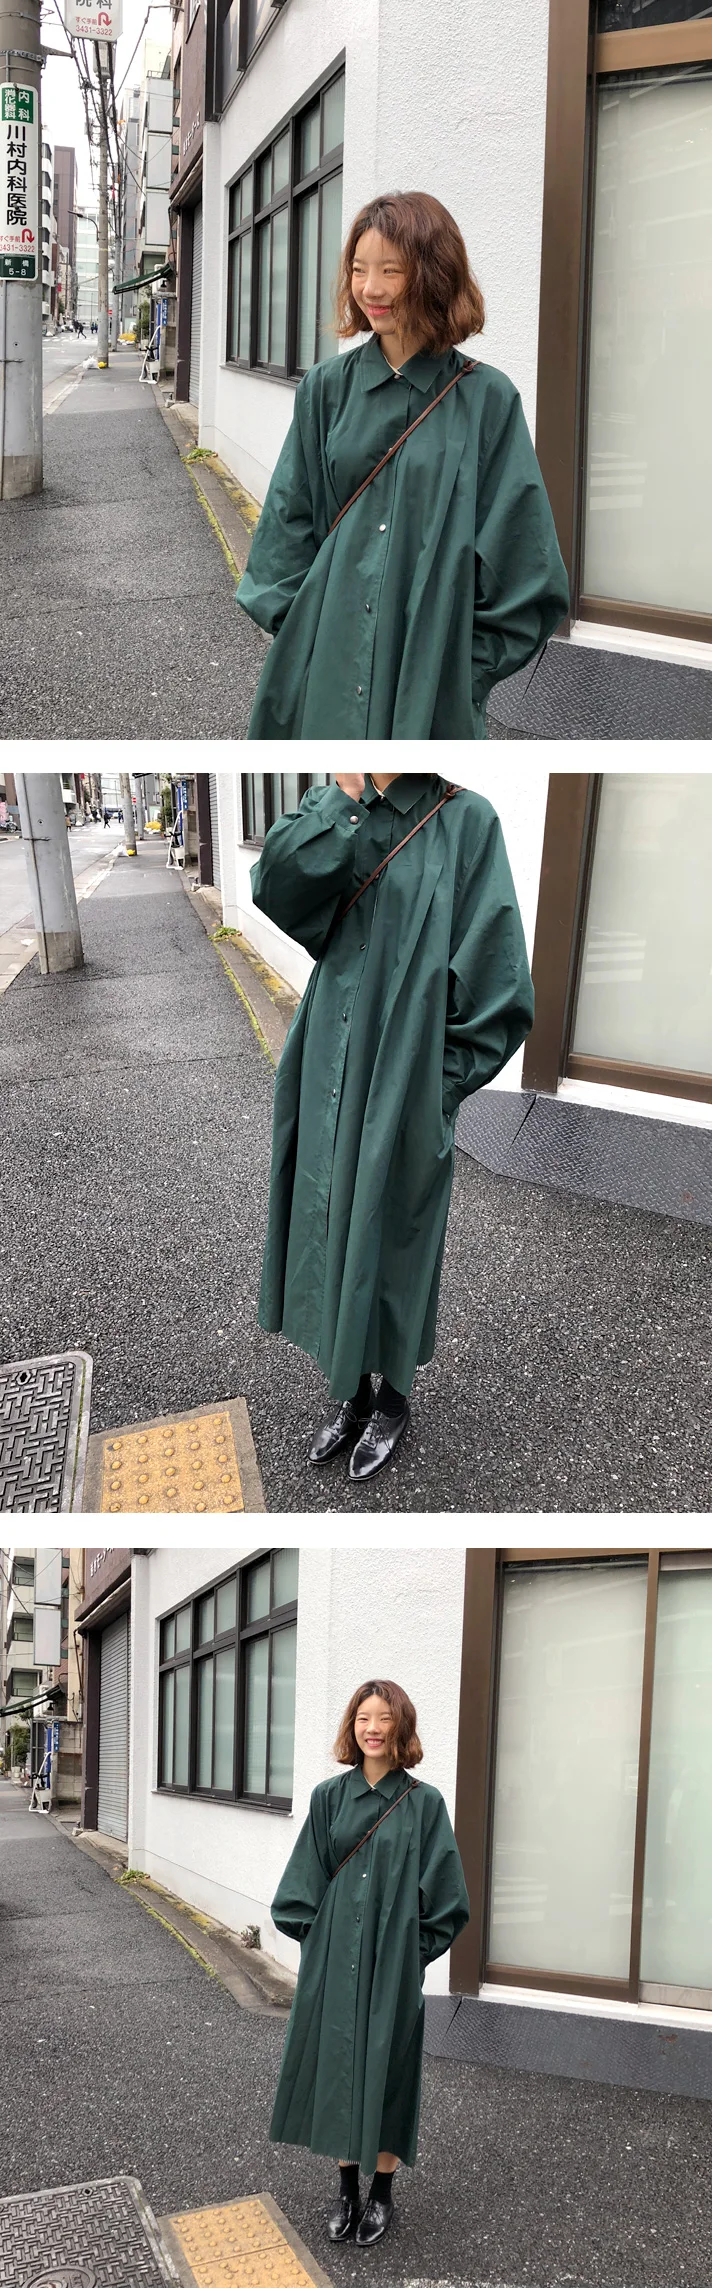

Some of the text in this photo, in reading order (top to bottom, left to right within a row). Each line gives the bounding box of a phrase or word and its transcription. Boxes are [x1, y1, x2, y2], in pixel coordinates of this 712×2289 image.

[75, 24, 112, 36] 3431-3322
[18, 91, 30, 121] 内科
[6, 124, 27, 226] 川村内科医院
[8, 267, 27, 276] 5-8
